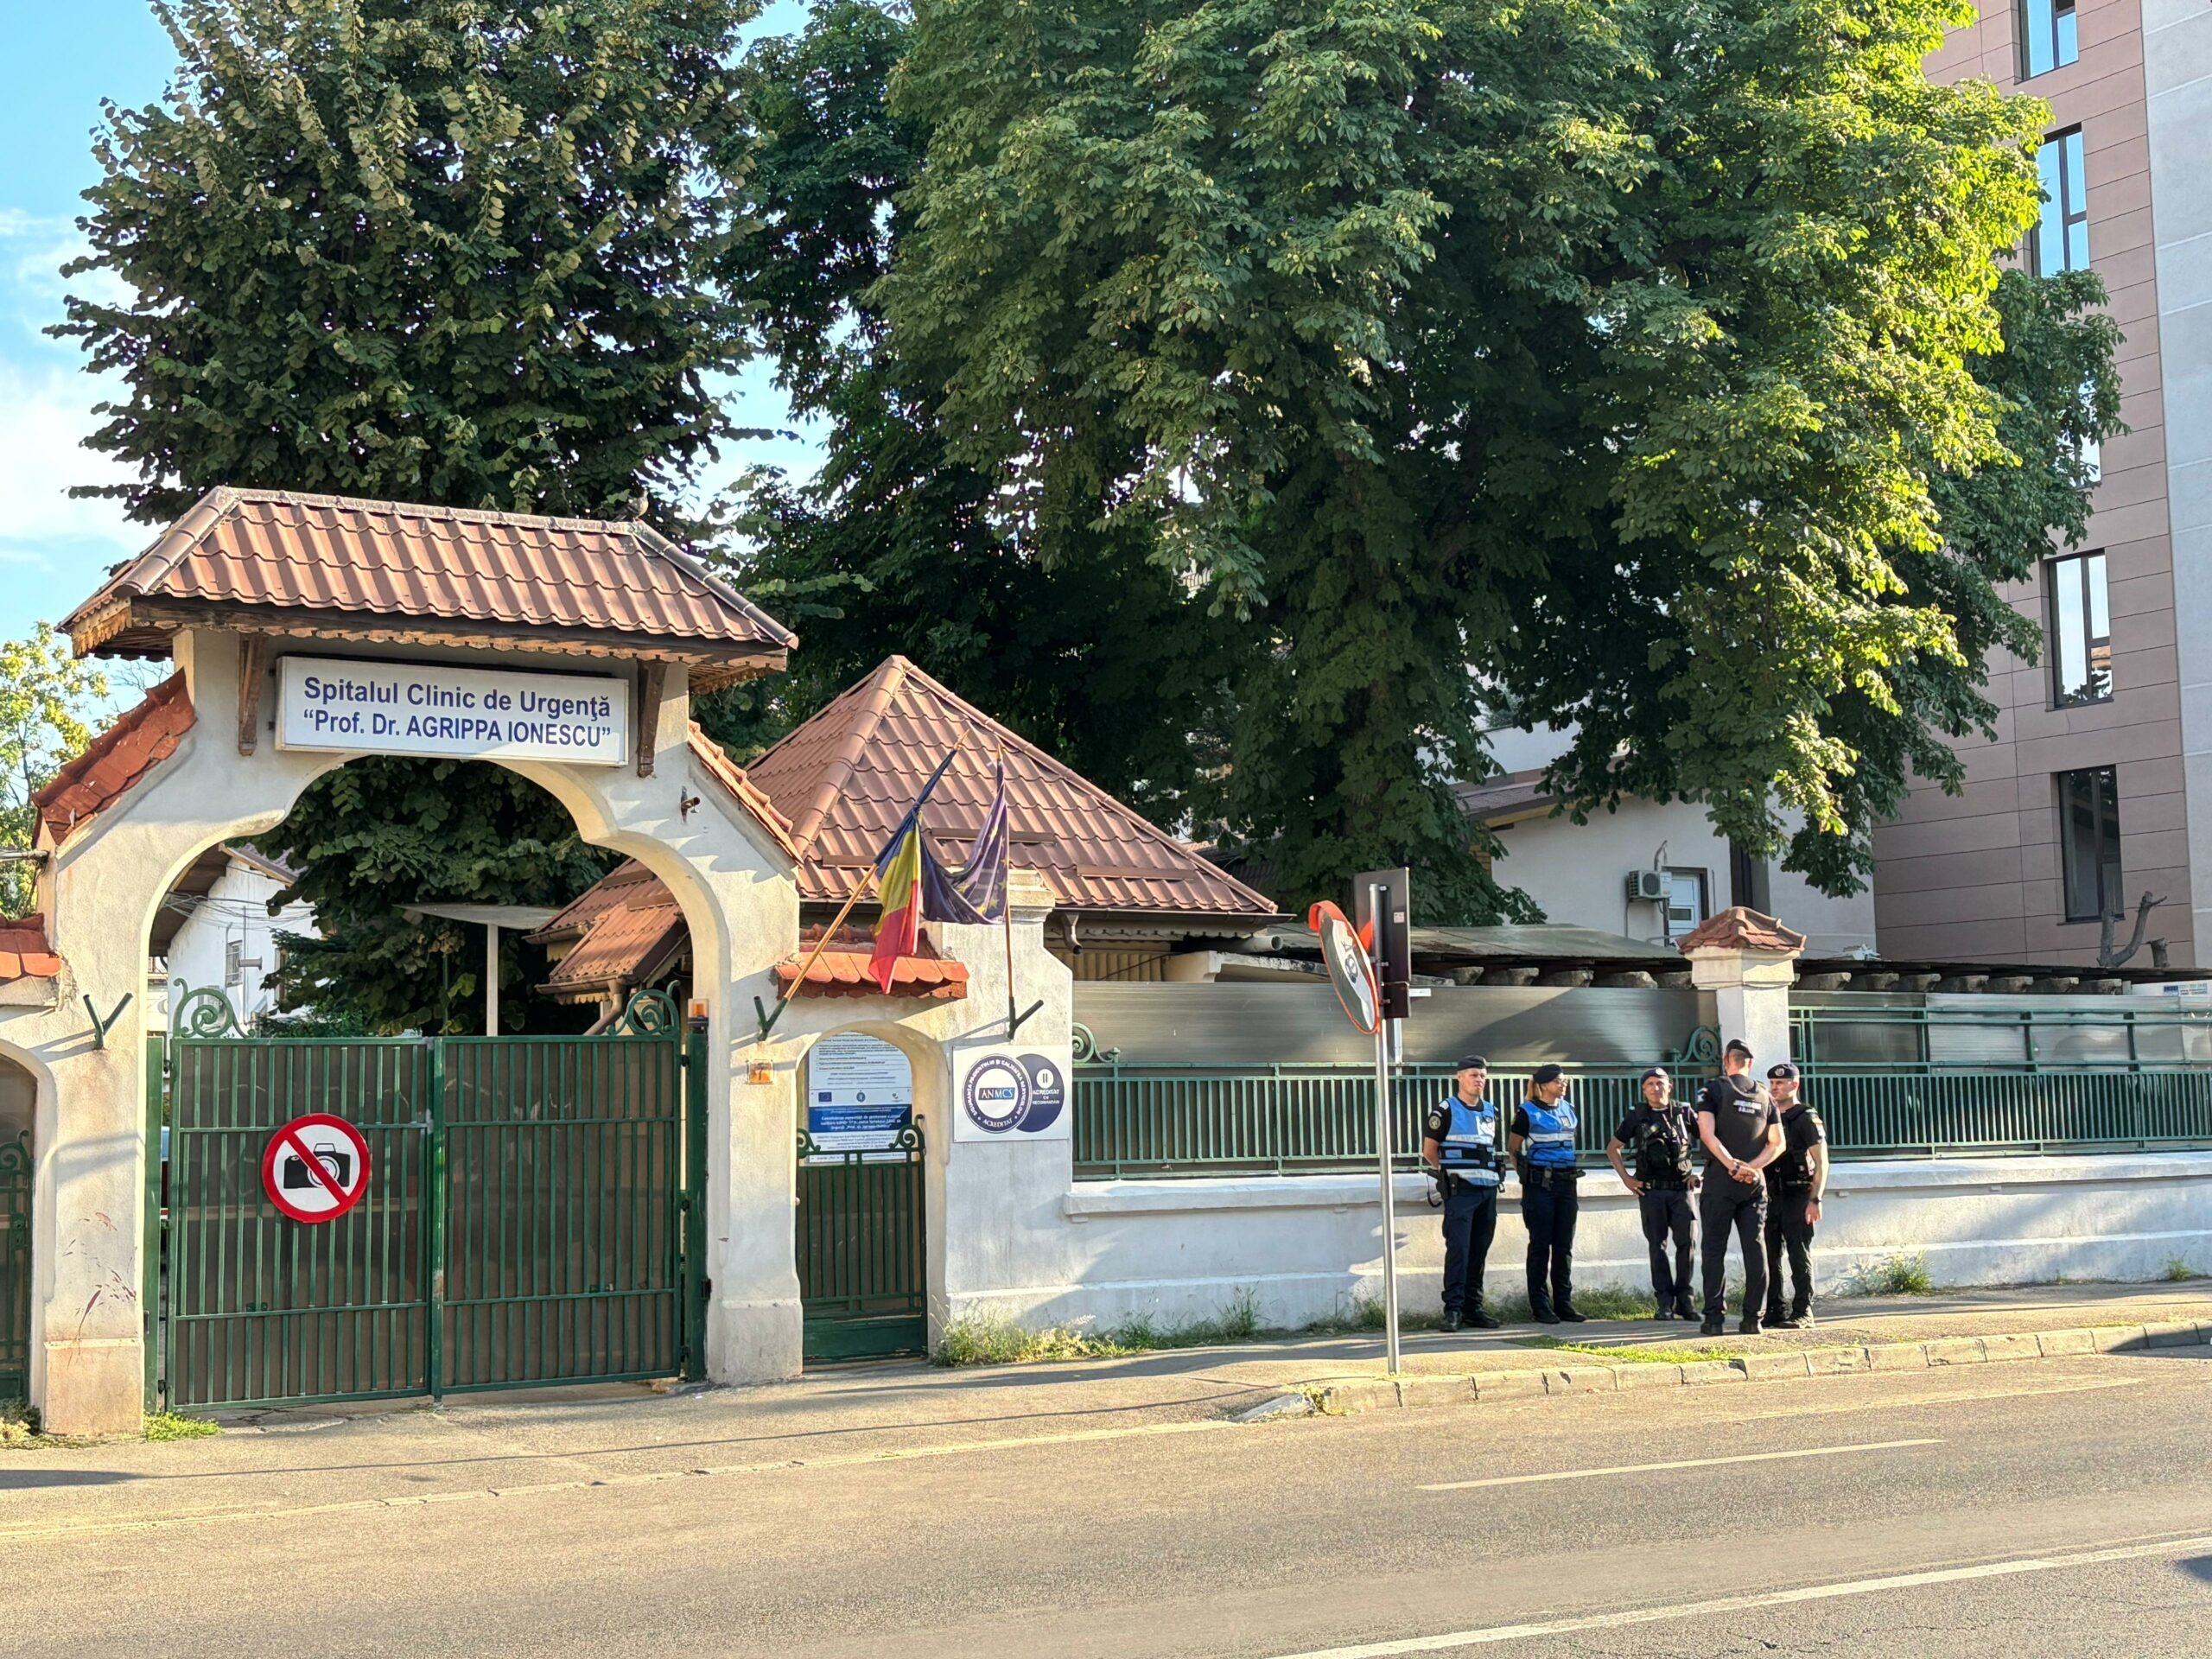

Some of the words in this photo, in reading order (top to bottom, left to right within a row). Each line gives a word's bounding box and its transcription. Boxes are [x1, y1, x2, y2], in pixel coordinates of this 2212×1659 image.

[304, 677, 398, 705] Spitalul
[407, 683, 475, 709] Clinic
[484, 689, 512, 710] de
[372, 713, 400, 735] Dr.
[406, 715, 502, 741] AGRIPPA
[982, 1089, 1013, 1099] ANMCS
[982, 1118, 1013, 1128] ACREDITAT
